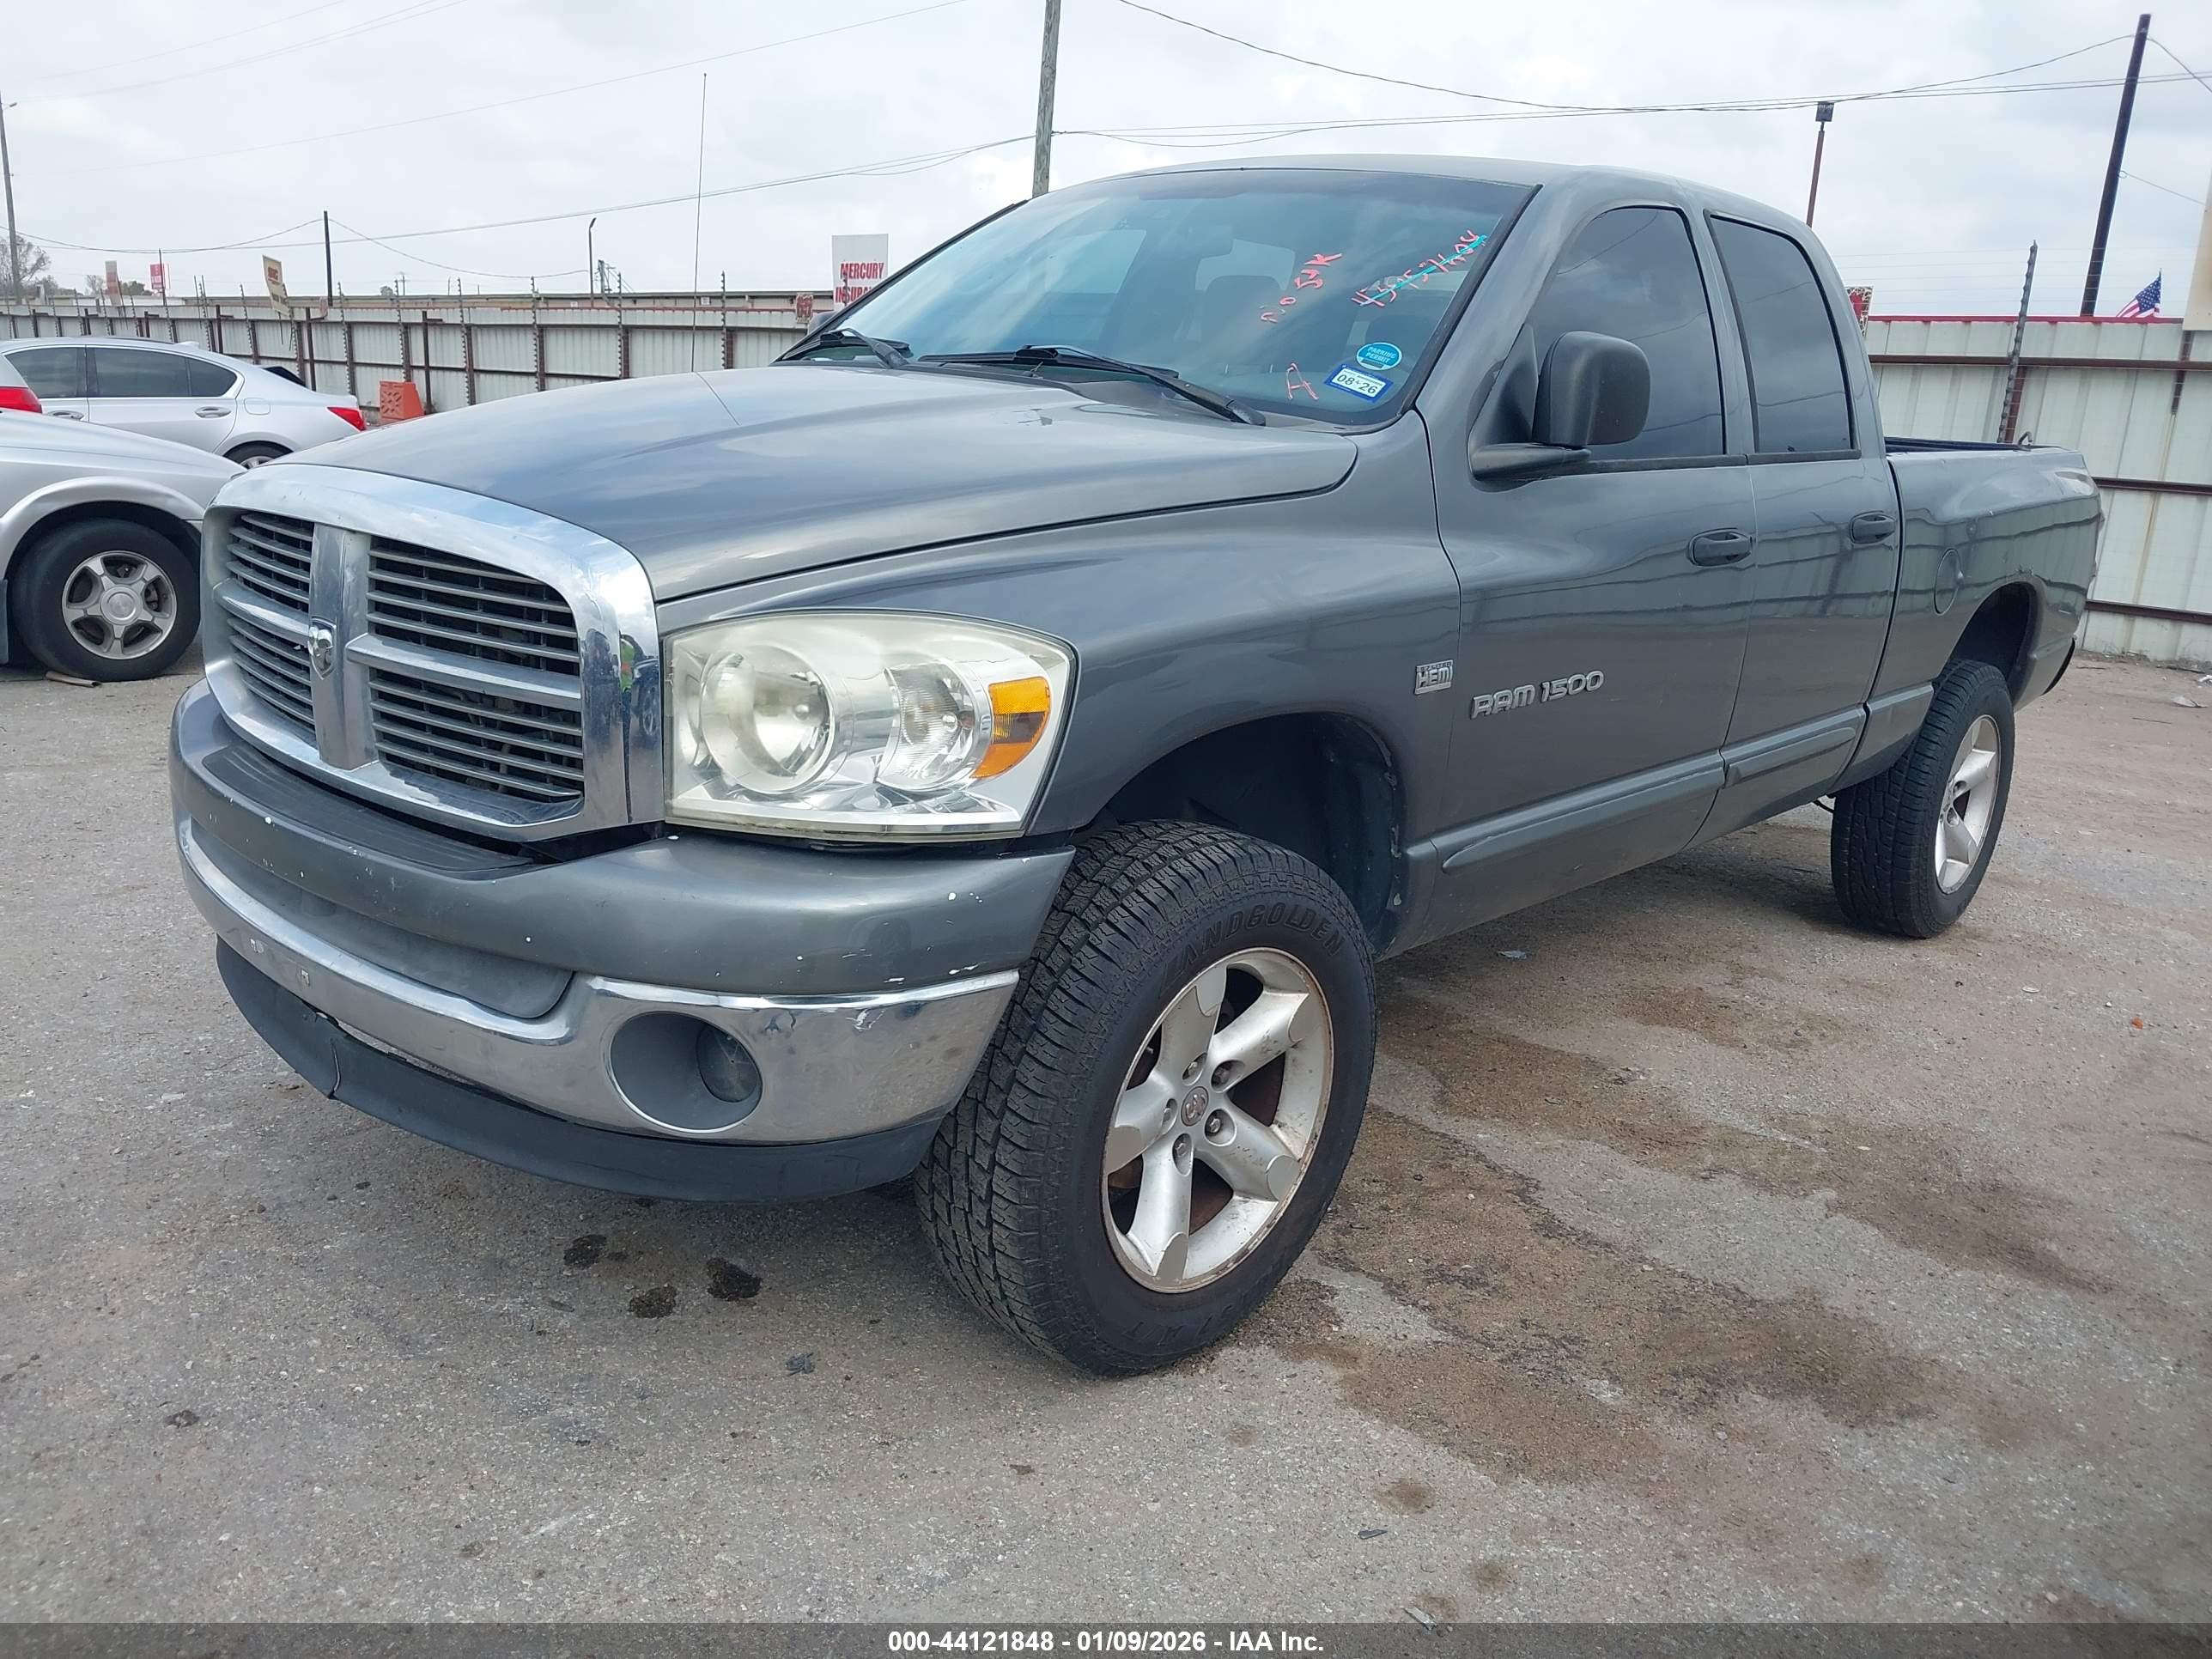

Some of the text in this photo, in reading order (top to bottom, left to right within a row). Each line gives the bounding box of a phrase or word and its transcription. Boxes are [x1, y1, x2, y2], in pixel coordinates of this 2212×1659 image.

[840, 262, 884, 280] MERCURY
[1365, 352, 1391, 363] PERMIT
[1367, 346, 1397, 359] PARKING
[1336, 374, 1355, 386] 08
[1358, 382, 1379, 394] 26
[1416, 665, 1454, 689] HEMI
[1470, 670, 1605, 720] RAM 1500
